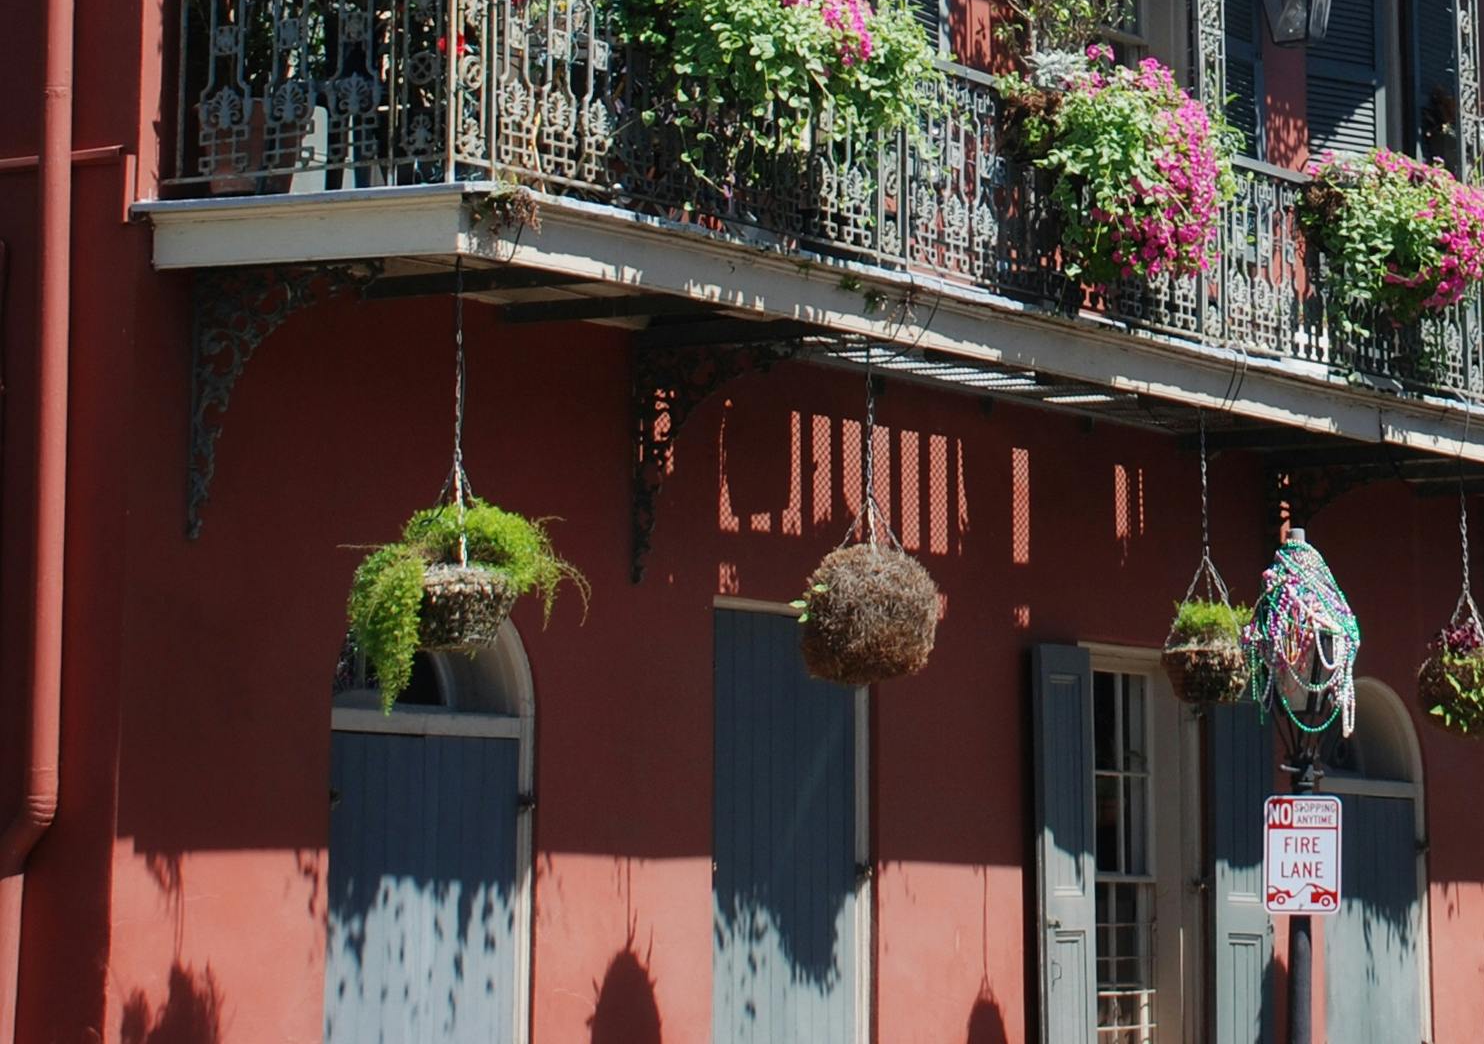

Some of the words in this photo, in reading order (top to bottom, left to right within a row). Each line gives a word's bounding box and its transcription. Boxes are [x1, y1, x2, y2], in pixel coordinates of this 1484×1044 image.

[1268, 803, 1292, 825] NO
[1297, 814, 1333, 825] ANYTIME
[1284, 836, 1321, 854] FIRE
[1281, 861, 1324, 879] LANE
